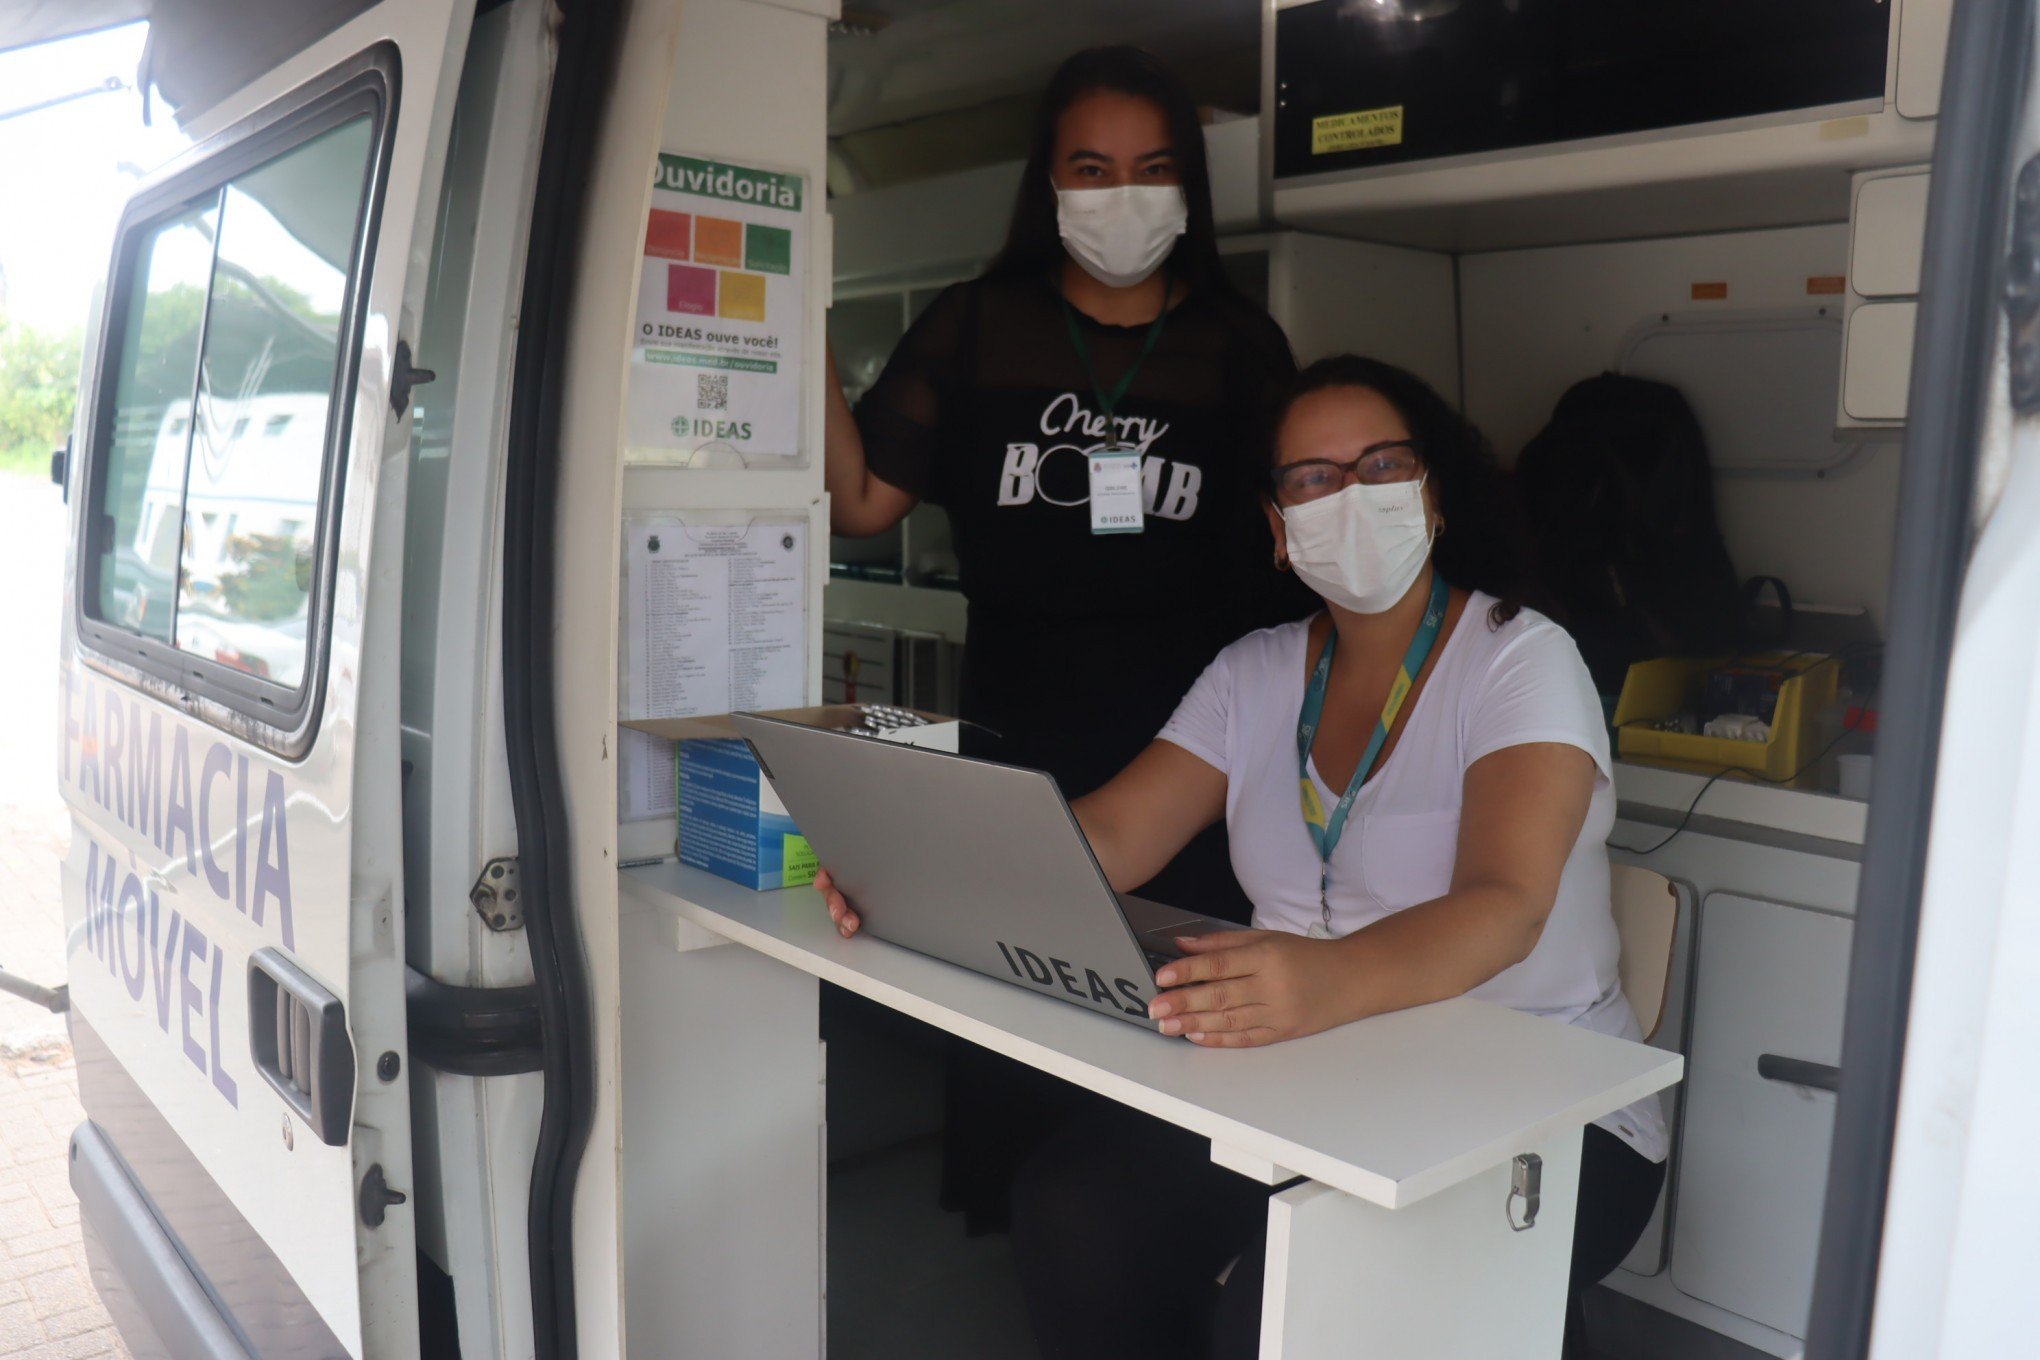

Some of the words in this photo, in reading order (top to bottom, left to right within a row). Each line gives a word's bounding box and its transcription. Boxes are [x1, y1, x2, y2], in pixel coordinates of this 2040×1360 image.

[642, 323, 653, 336] O
[658, 325, 702, 341] IDEAS
[707, 332, 739, 345] ouve
[744, 336, 779, 349] você!
[693, 419, 752, 440] IDEAS
[1040, 393, 1169, 452] Cherry
[1109, 515, 1136, 524] IDEAS
[85, 841, 239, 1111] MÓVEL
[996, 940, 1150, 1020] IDEAS
